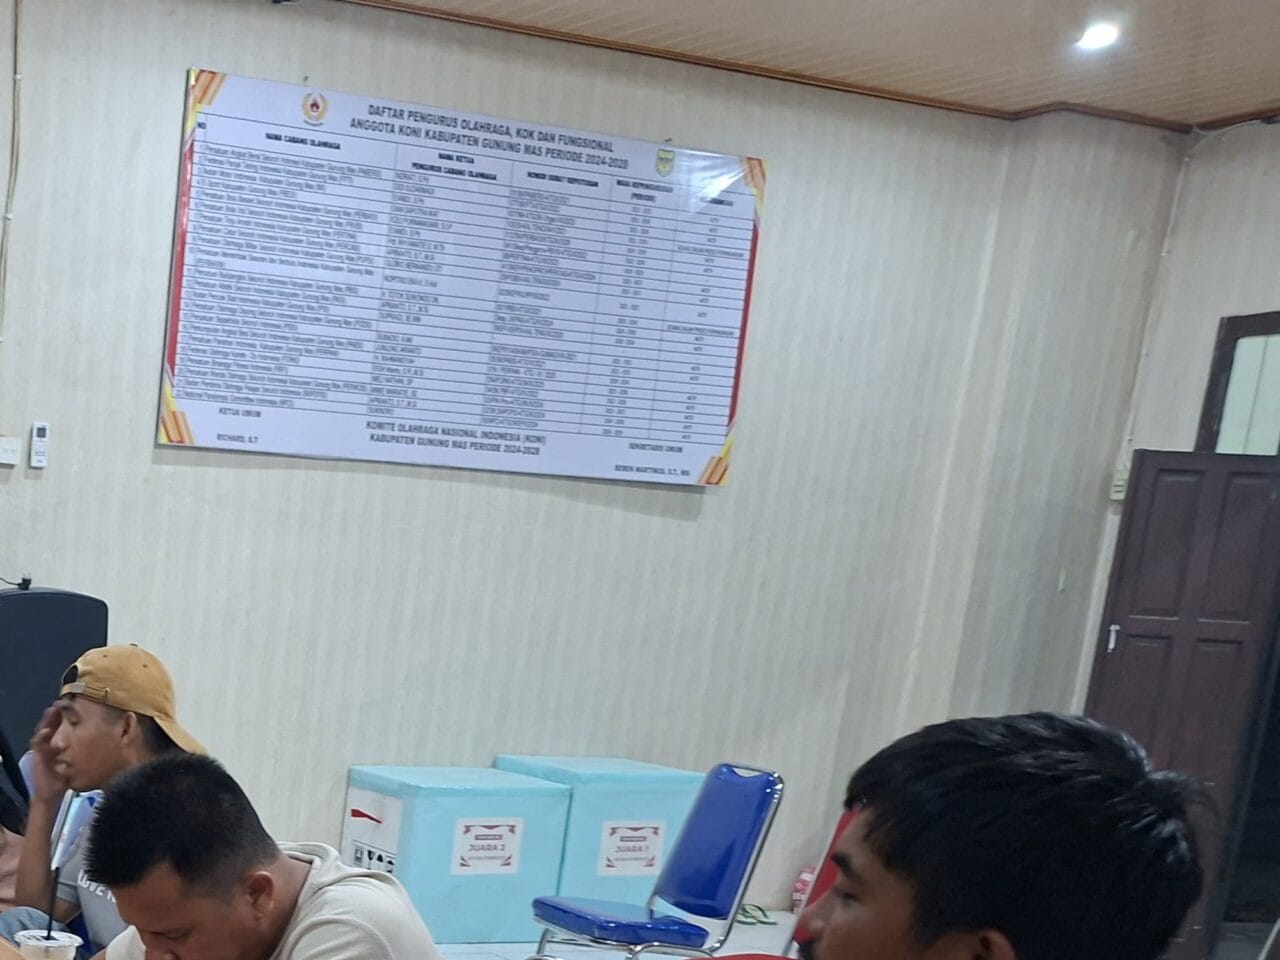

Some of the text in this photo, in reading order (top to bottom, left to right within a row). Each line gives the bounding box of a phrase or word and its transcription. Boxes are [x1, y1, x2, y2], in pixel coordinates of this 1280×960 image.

[349, 117, 395, 135] ANGGOTA
[398, 125, 421, 138] KONI
[424, 129, 479, 147] KABUPATEN
[481, 137, 521, 153] GUNUNG
[523, 143, 543, 156] MAS
[545, 147, 583, 162] PERIODE
[367, 104, 405, 120] DAFTAR
[406, 110, 458, 128] PENGURUS
[460, 118, 513, 137] OLAHRAGA,
[537, 130, 556, 143] DAN
[558, 133, 614, 152] FUNGSIONAL
[365, 420, 396, 432] KOMITE
[397, 423, 439, 436] OLAHRAGA
[440, 426, 478, 439] NASIONAL
[480, 430, 521, 442] INDONESIA
[369, 433, 415, 445] KABUPATEN
[416, 437, 449, 448] GUNUNG
[451, 439, 467, 449] MAS
[469, 441, 501, 452] PERIODE
